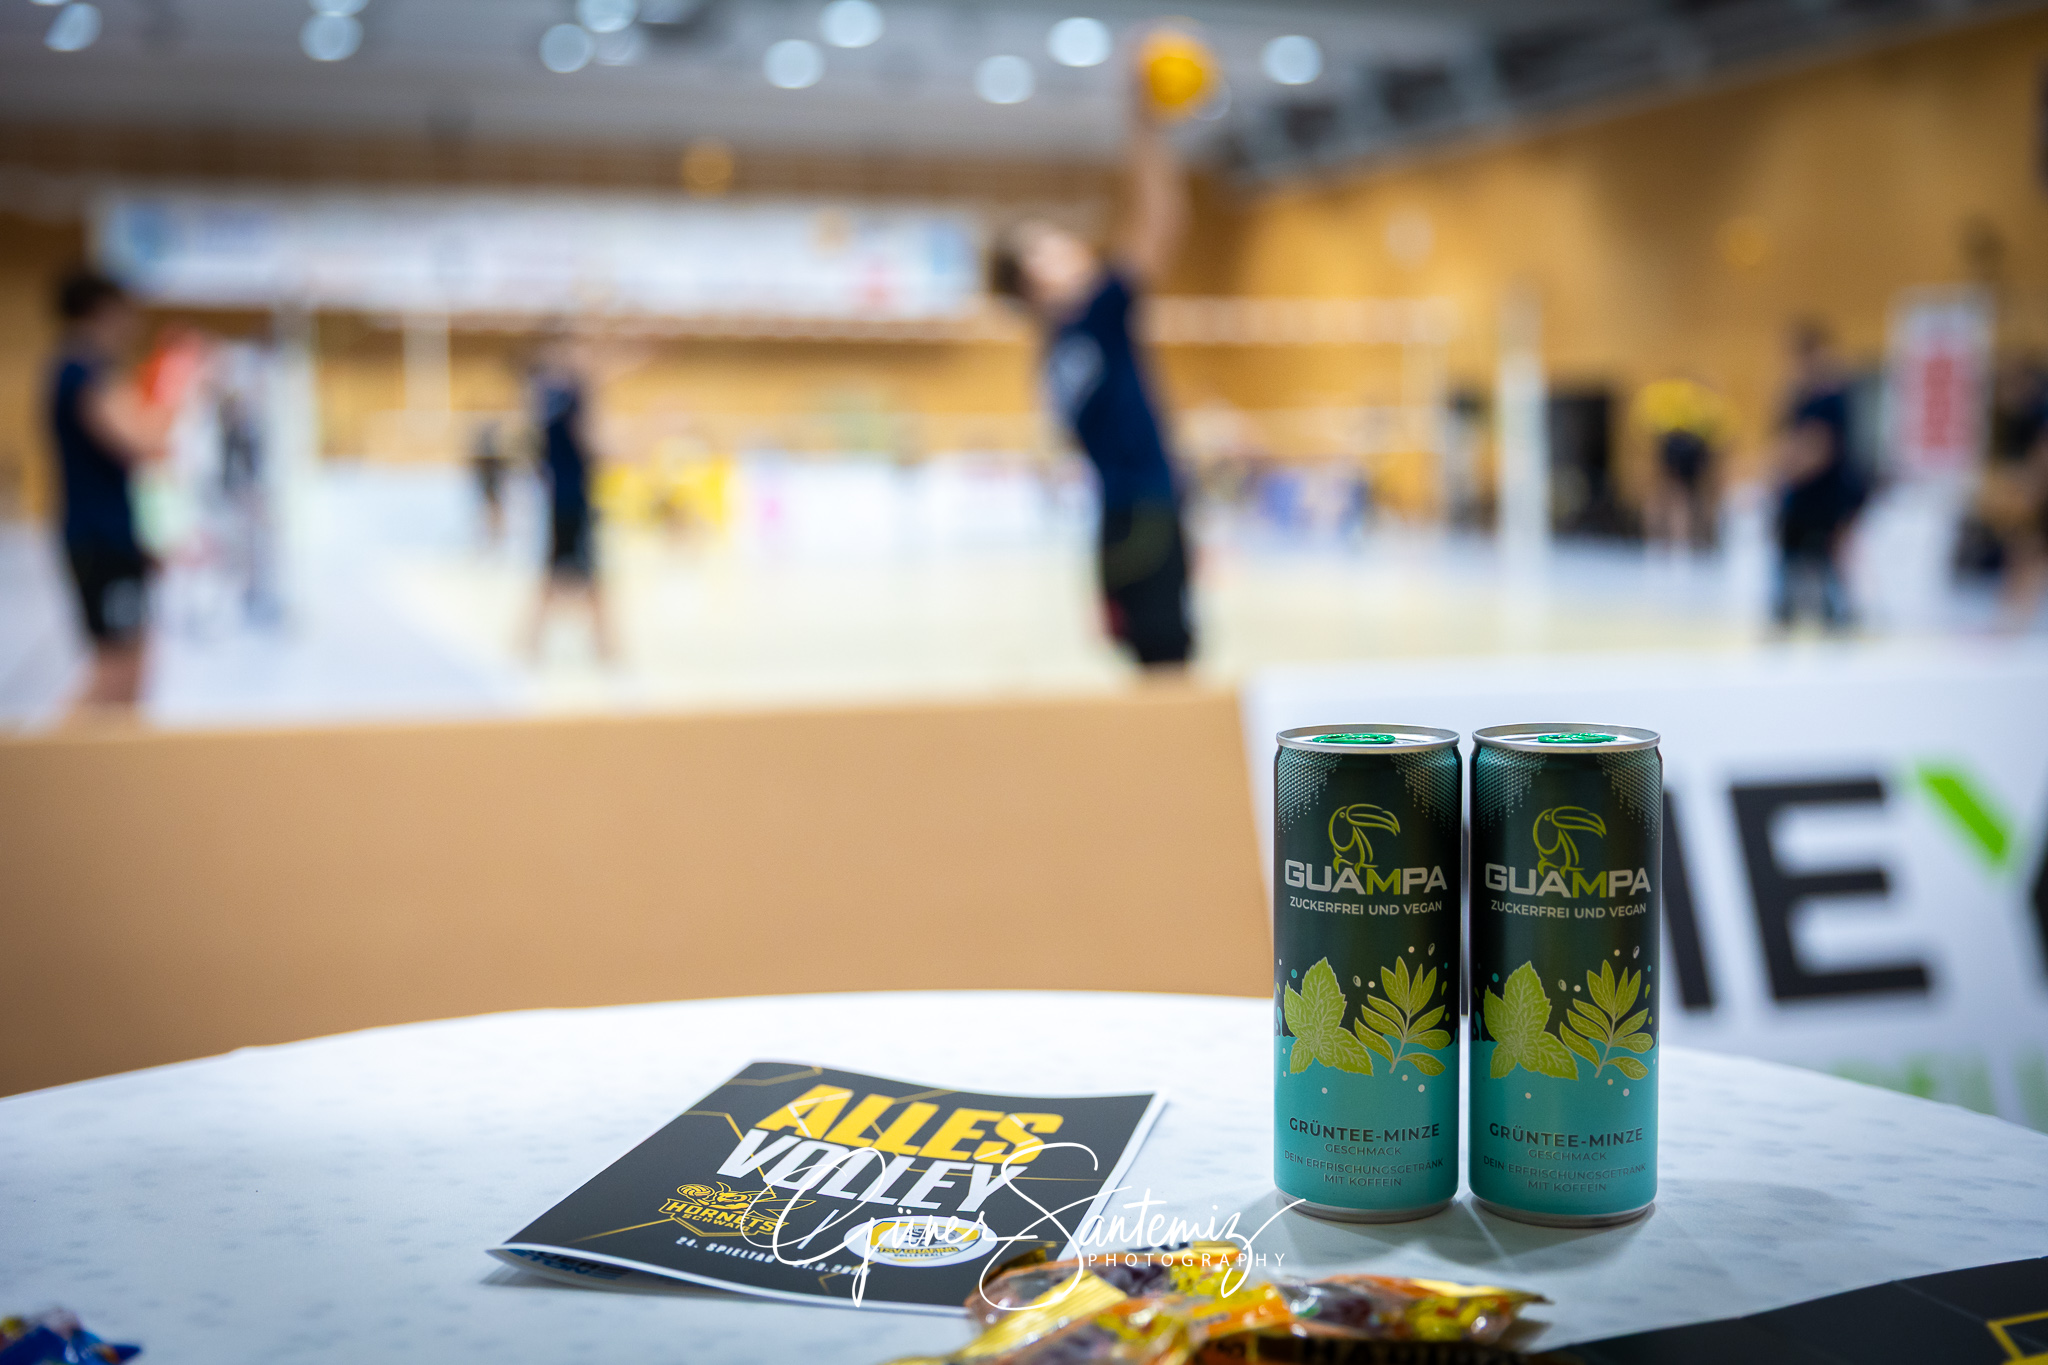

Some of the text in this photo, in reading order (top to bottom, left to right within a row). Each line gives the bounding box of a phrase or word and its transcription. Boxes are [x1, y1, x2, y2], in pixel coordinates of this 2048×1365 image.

[1284, 859, 1448, 895] GUAMPA
[1485, 862, 1652, 898] GUAMPA
[1289, 896, 1443, 916] ZUCKERFREI UND VEGAN
[1490, 900, 1647, 919] ZUCKERFREI UND VEGAN
[754, 1083, 1064, 1165] ALLES
[1289, 1117, 1440, 1142] GRÜNTEE-MINZE
[1489, 1122, 1643, 1148] GRÜNTEE-MINZE
[1324, 1143, 1402, 1156] GESCHMACK
[1528, 1149, 1607, 1161] GESCHMACK
[716, 1128, 1028, 1213] VOLLEY
[1284, 1150, 1444, 1175] DEIN ERFRISCHUNGSGETRÄNK
[1483, 1156, 1505, 1170] DEIN
[1323, 1173, 1402, 1187] MIT KOFFEIN
[1527, 1180, 1607, 1193] MIT KOFFEIN
[666, 1201, 777, 1232] HORNETS
[682, 1213, 751, 1232] SCHWAIG
[675, 1236, 699, 1249] 24.
[705, 1242, 776, 1264] SPIELTAG
